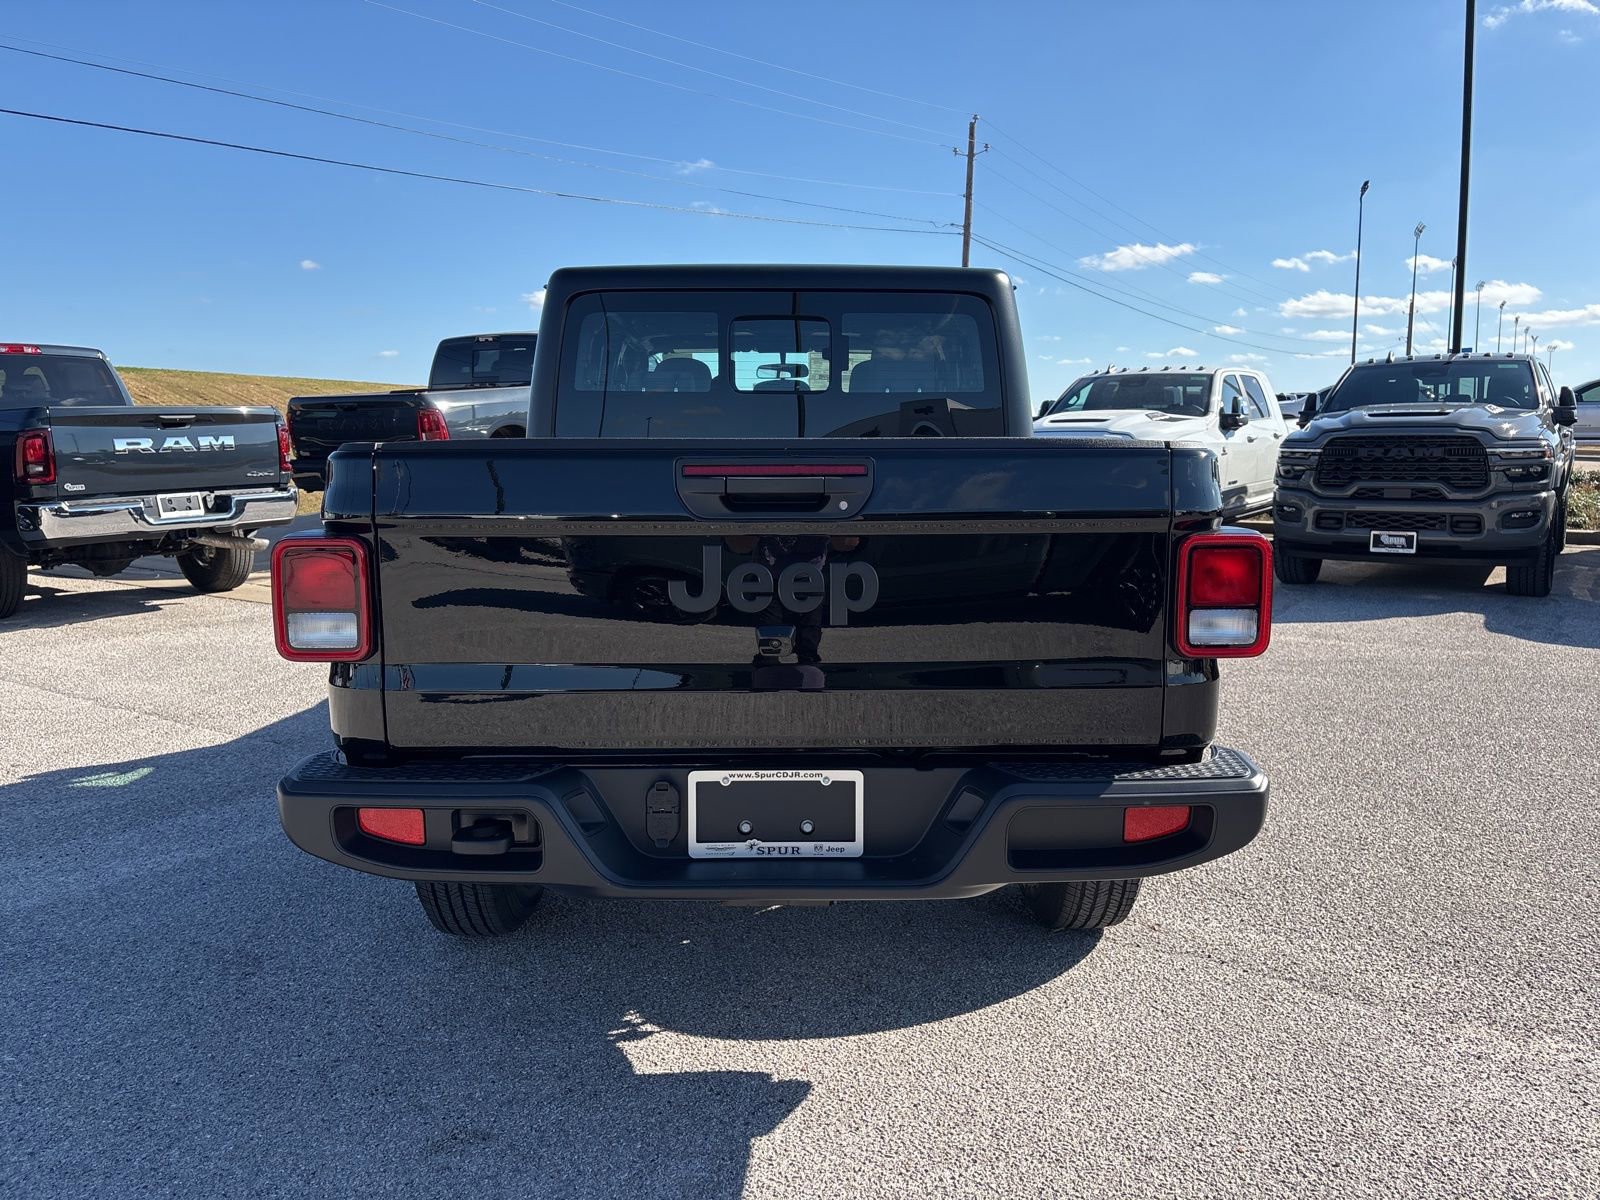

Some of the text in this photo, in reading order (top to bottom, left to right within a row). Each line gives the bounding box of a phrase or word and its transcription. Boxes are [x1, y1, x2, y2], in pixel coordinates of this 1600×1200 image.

[113, 435, 236, 455] RAM
[1358, 447, 1444, 458] RAM
[668, 545, 879, 626] Jeep
[728, 771, 823, 779] www.SpurCDJR.com
[756, 846, 801, 855] SPUR
[825, 845, 846, 854] Jeep
